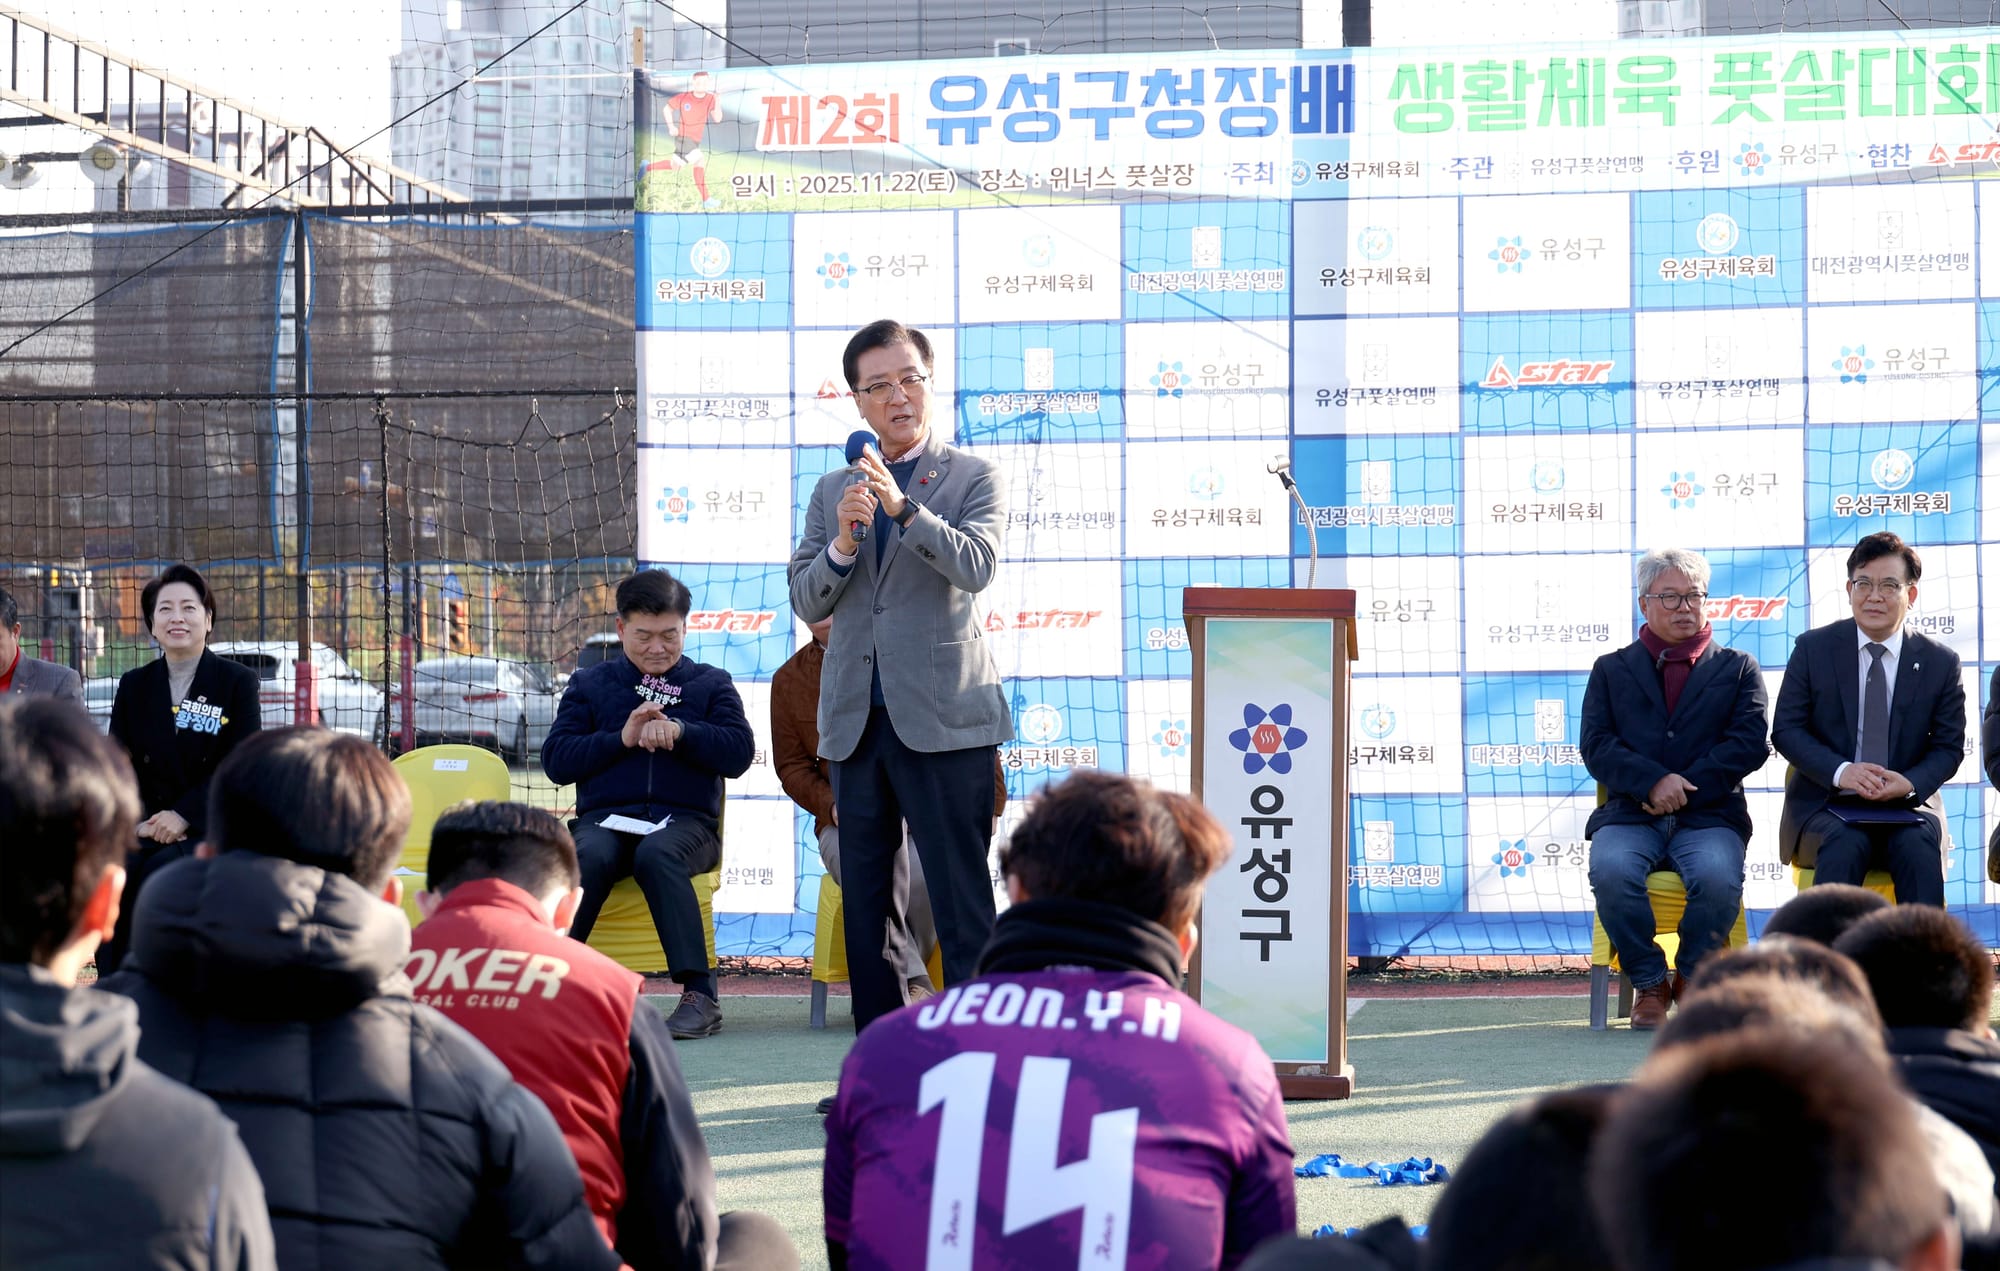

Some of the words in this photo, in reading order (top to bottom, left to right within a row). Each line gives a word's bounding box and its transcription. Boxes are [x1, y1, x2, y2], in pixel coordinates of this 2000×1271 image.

[761, 92, 900, 146] 제2회
[926, 64, 1356, 146] 유성구청장배
[1387, 55, 1682, 134] 생활체육
[1708, 42, 2000, 125] 풋살대회
[1530, 155, 1644, 176] 유성구풋살연맹
[1778, 143, 1839, 165] 유성구
[731, 174, 776, 198] 일시
[799, 169, 957, 195] 2025.11.22(토)
[979, 168, 1026, 192] 장소
[1049, 165, 1117, 190] 위너스
[1125, 162, 1195, 188] 풋살장
[1315, 160, 1420, 181] 유성구체육회
[1539, 237, 1606, 261] 유성구
[864, 254, 929, 278] 유성구
[1660, 256, 1775, 279] 유성구체육회
[1811, 252, 1970, 275] 대전광역시풋살연맹
[984, 273, 1094, 295] 유성구체육회
[1319, 266, 1431, 287] 유성구체육회
[657, 280, 765, 301] 유성구체육회
[1882, 347, 1951, 371] 유성구
[1199, 363, 1265, 387] 유성구
[1314, 386, 1437, 408] 유성구풋살연맹
[1657, 377, 1780, 400] 유성구풋살연맹
[655, 399, 769, 418] 유성구풋살연맹
[979, 392, 1099, 414] 유성구풋살연맹
[1711, 472, 1780, 497] 유성구
[703, 490, 766, 513] 유성구
[1490, 501, 1604, 524] 유성구체육회
[1834, 492, 1950, 516] 유성구체육회
[1150, 506, 1263, 527] 유성구체육회
[1369, 599, 1437, 622] 유성구
[1487, 623, 1610, 644] 유성구풋살연맹
[1541, 842, 1586, 867] 유성
[1239, 784, 1293, 962] 유성구
[403, 947, 571, 1000] OKER
[465, 993, 521, 1010] CLUB
[916, 1051, 1140, 1271] 14
